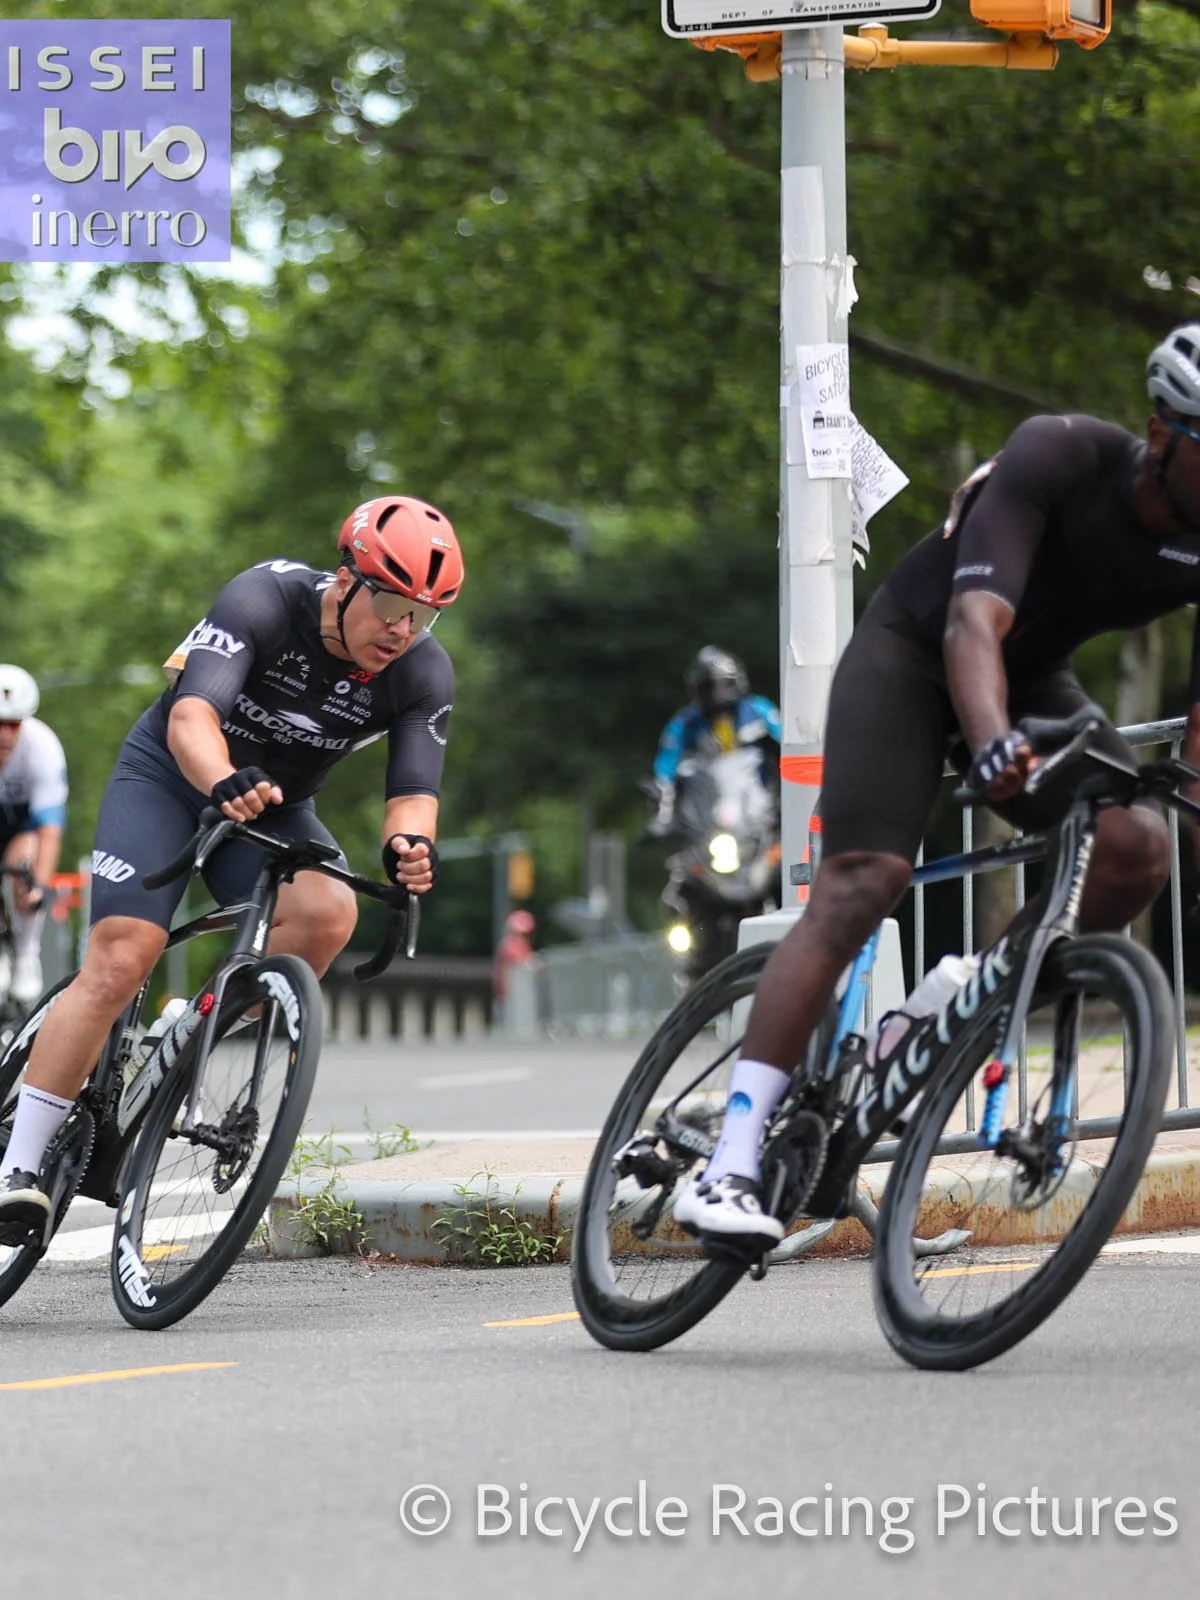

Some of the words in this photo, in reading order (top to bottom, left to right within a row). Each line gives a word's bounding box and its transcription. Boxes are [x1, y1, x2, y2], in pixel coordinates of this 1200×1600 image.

[721, 11, 746, 20] DEPT
[762, 8, 774, 16] OF
[790, 1, 881, 13] TRANSPORTATION
[321, 704, 364, 725] SRAM
